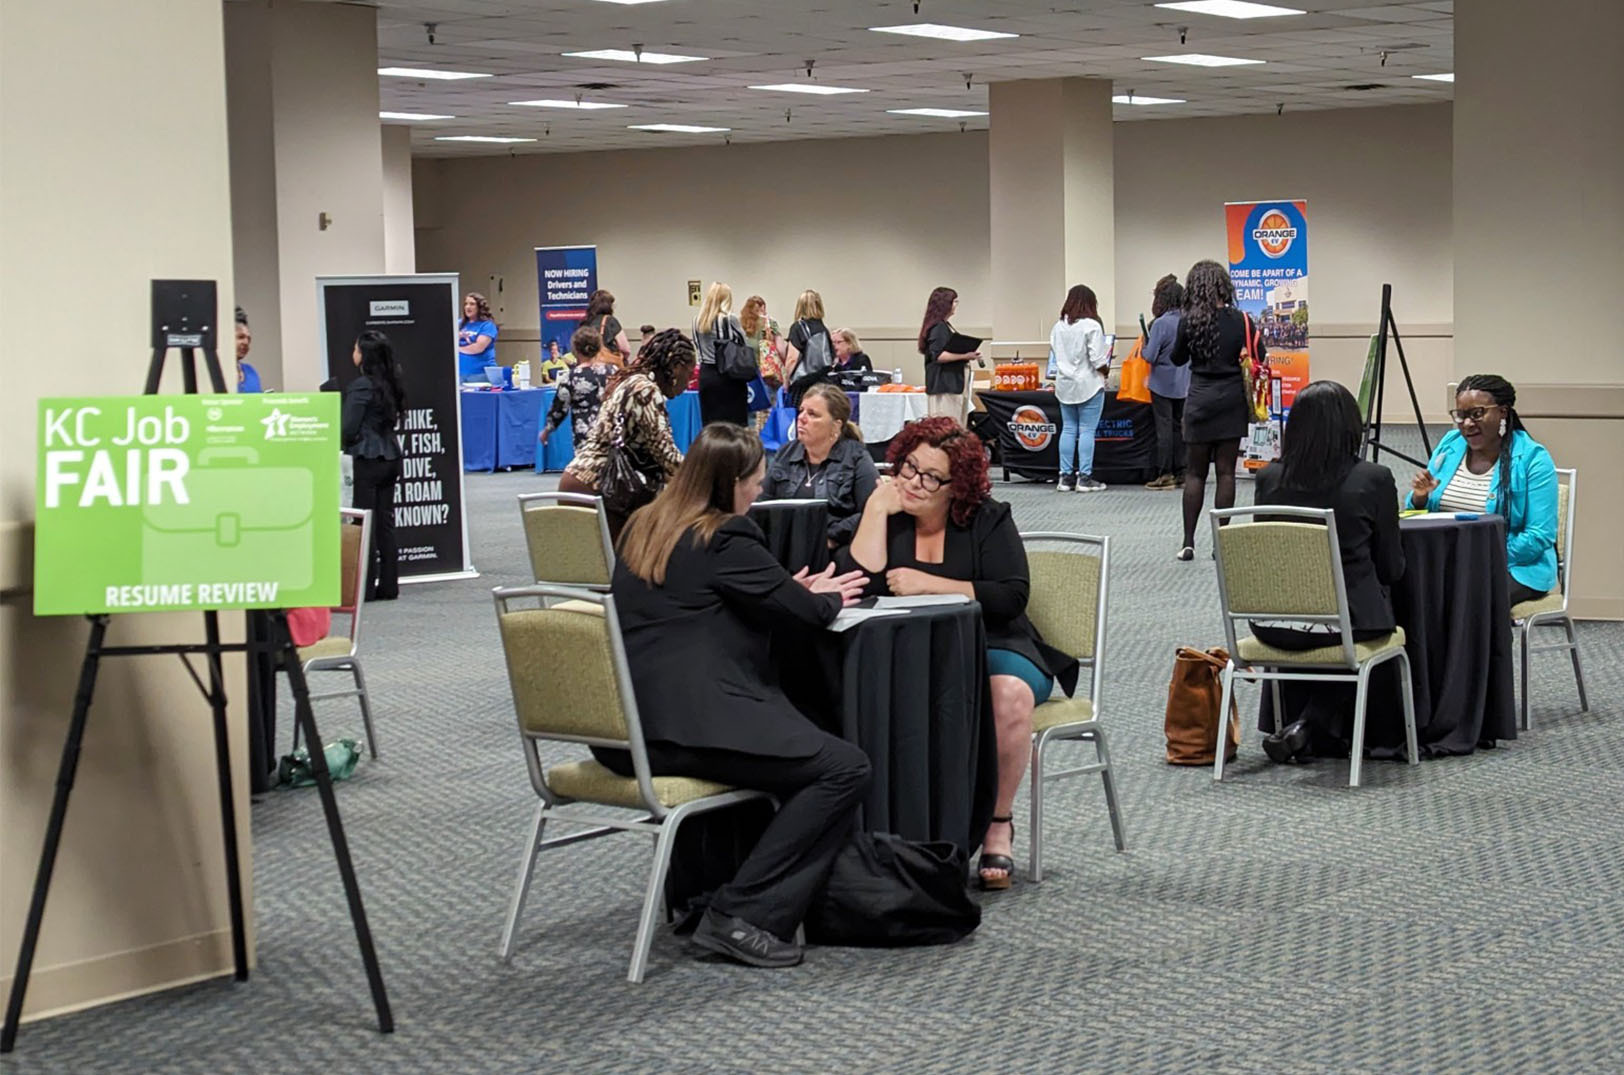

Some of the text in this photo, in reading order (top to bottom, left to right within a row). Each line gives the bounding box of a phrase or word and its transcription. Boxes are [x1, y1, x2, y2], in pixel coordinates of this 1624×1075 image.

[1254, 230, 1295, 238] ORANGE
[544, 268, 589, 278] NOW HIRING
[1231, 269, 1250, 278] COME
[1250, 269, 1261, 277] BE
[1296, 268, 1303, 276] A
[547, 280, 587, 289] Drivers and
[1263, 279, 1297, 287] GROWING
[547, 291, 588, 300] Technicians
[1236, 288, 1264, 300] EAM!
[403, 408, 438, 430] HIKE,
[1098, 419, 1133, 429] ECTRIC
[45, 405, 190, 447] KC Job
[1009, 424, 1055, 433] ORANGE
[411, 433, 446, 455] FISH,
[403, 457, 437, 479] DIVE,
[45, 448, 191, 508] FAIR
[405, 480, 442, 503] ROAM
[403, 546, 434, 554] PASSION
[105, 582, 278, 607] RESUME REVIEW
